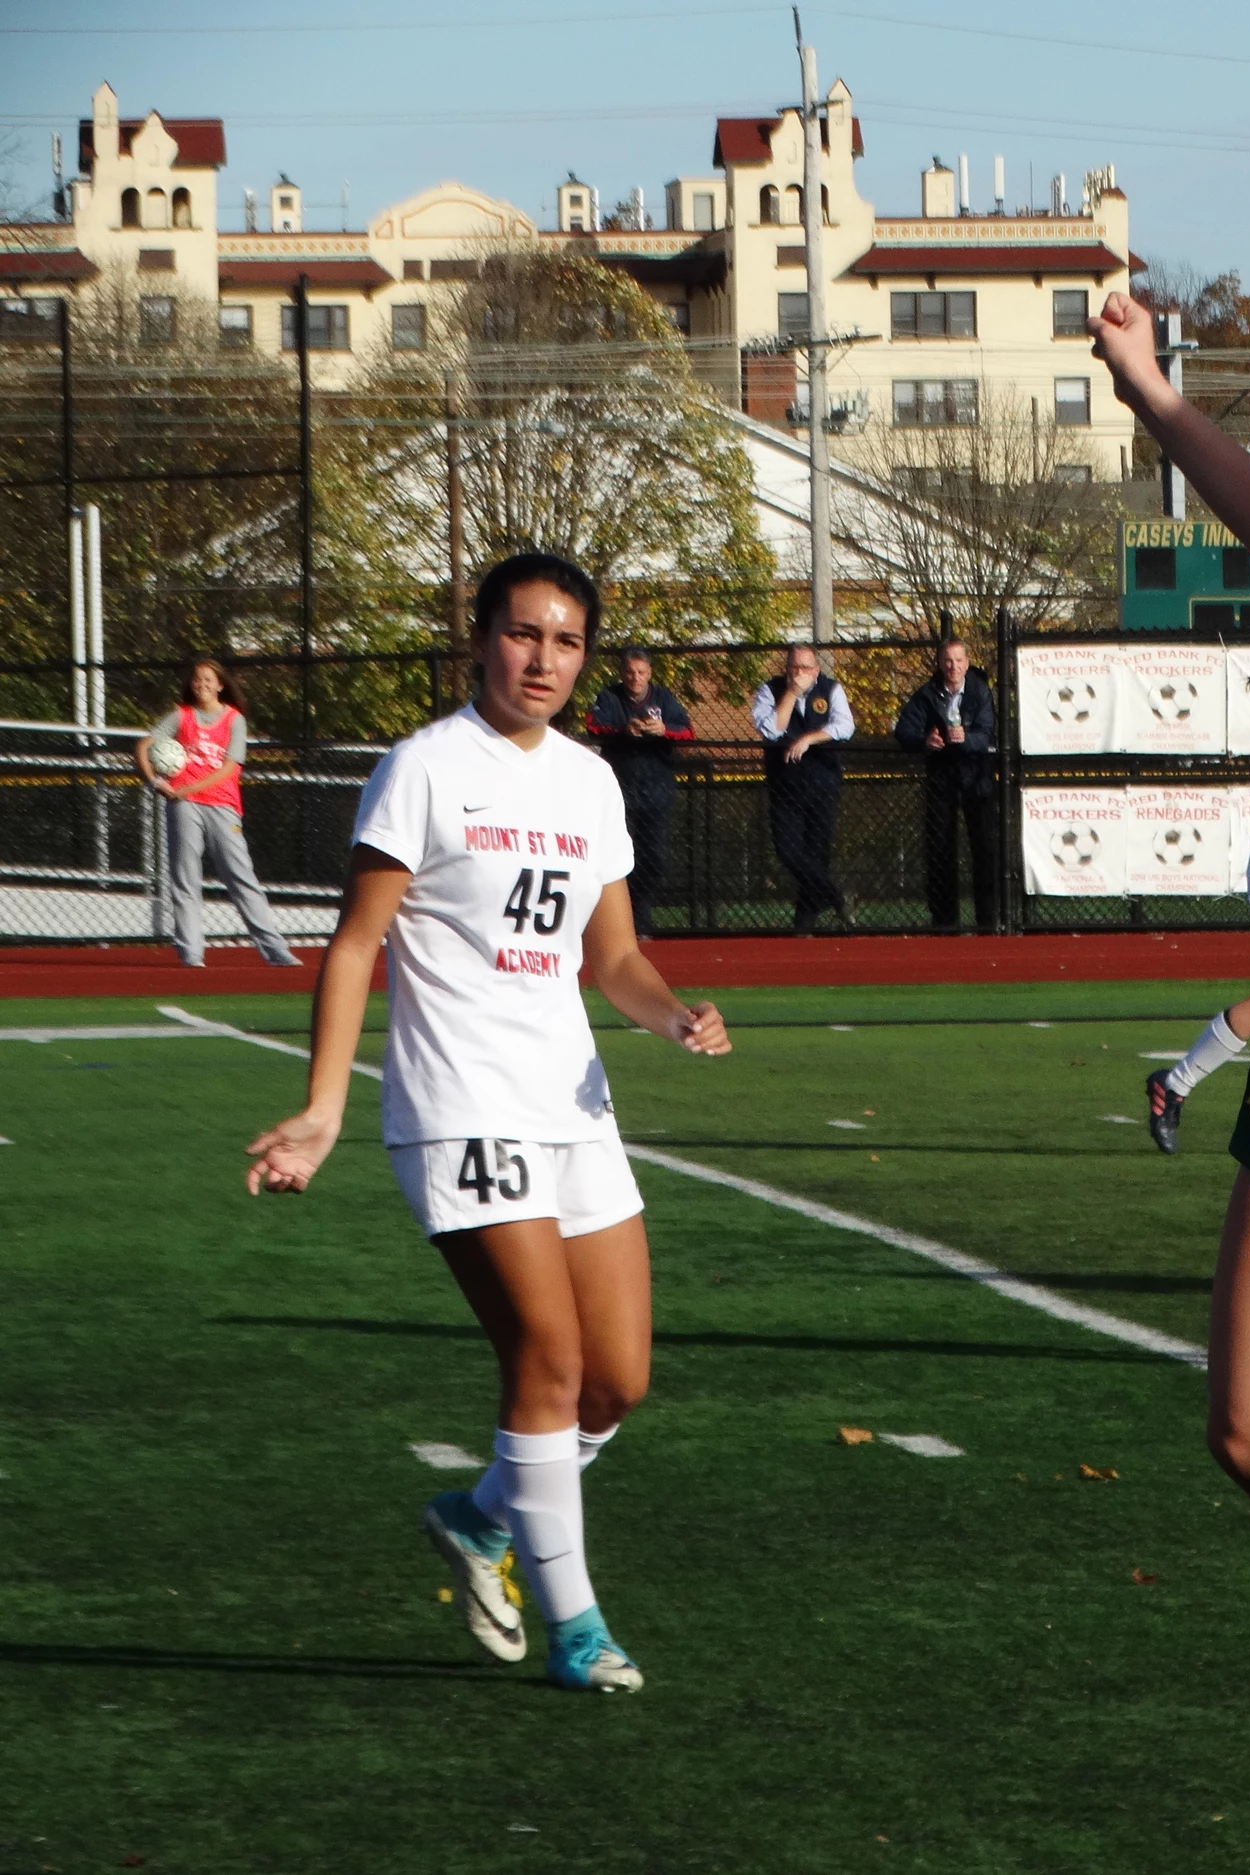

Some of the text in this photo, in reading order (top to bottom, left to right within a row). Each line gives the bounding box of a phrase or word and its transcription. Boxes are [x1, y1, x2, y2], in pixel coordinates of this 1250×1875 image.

[1125, 523, 1194, 547] CASEYS
[1021, 653, 1049, 669] RED
[1054, 650, 1097, 661] BANK
[1123, 653, 1152, 667] RED
[1158, 650, 1200, 661] BANK
[1206, 655, 1225, 668] FC
[1031, 664, 1111, 677] ROCKERS
[1135, 665, 1213, 677] ROCKERS
[1169, 732, 1211, 741] SHOWCASE
[1052, 743, 1096, 751] CHAMPIONS
[1151, 743, 1196, 751] CHAMPIONS
[1025, 792, 1126, 810] RED BANK FC
[1129, 791, 1229, 808] RED BANK FC
[1029, 809, 1122, 821] ROCKERS
[1136, 808, 1220, 821] RENEGADES
[464, 825, 588, 862] MOUNT ST MARY
[1161, 874, 1181, 883] BOYS
[1183, 874, 1220, 883] NATIONAL
[1155, 884, 1199, 892] CHAMPIONS
[503, 868, 571, 936] 45
[494, 947, 561, 978] ACADEMY
[457, 1138, 531, 1205] 45
